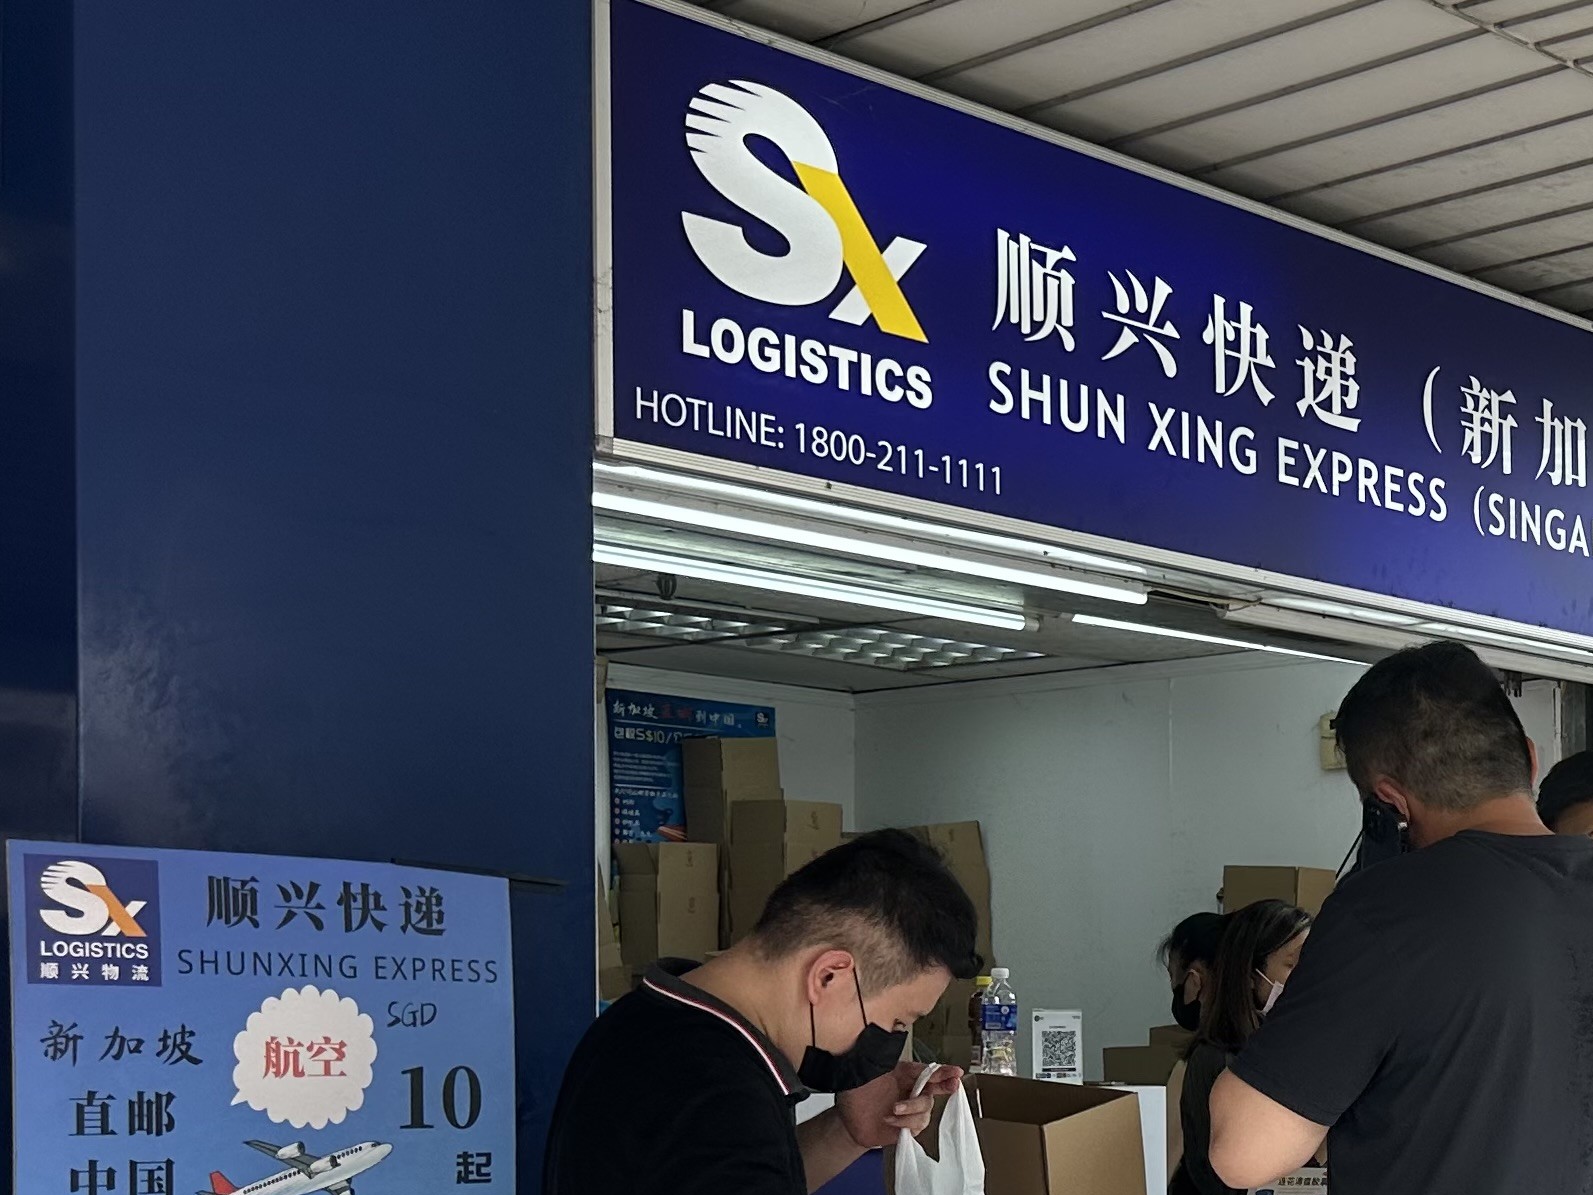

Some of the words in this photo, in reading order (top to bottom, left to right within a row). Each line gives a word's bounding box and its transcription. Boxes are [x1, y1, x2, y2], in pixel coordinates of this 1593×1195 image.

[681, 308, 934, 410] LOGISTICS
[634, 386, 786, 450] HOTLINE:
[793, 422, 1003, 496] 1800-211-1111
[988, 361, 1127, 444] SHUN
[1147, 400, 1258, 476] XING
[1278, 440, 1448, 523] EXPRESS
[206, 875, 447, 937] 顺兴快递
[40, 940, 149, 959] LOGISTICS
[40, 962, 150, 982] 顺兴物流
[177, 948, 358, 980] SHUNXING
[375, 957, 498, 984] EXPRESS
[386, 1001, 437, 1029] SGD
[40, 1020, 204, 1067] 新加坡
[262, 1035, 348, 1080] 航空
[68, 1091, 177, 1138] 直邮
[401, 1065, 482, 1130] 10
[456, 1152, 493, 1186] 起
